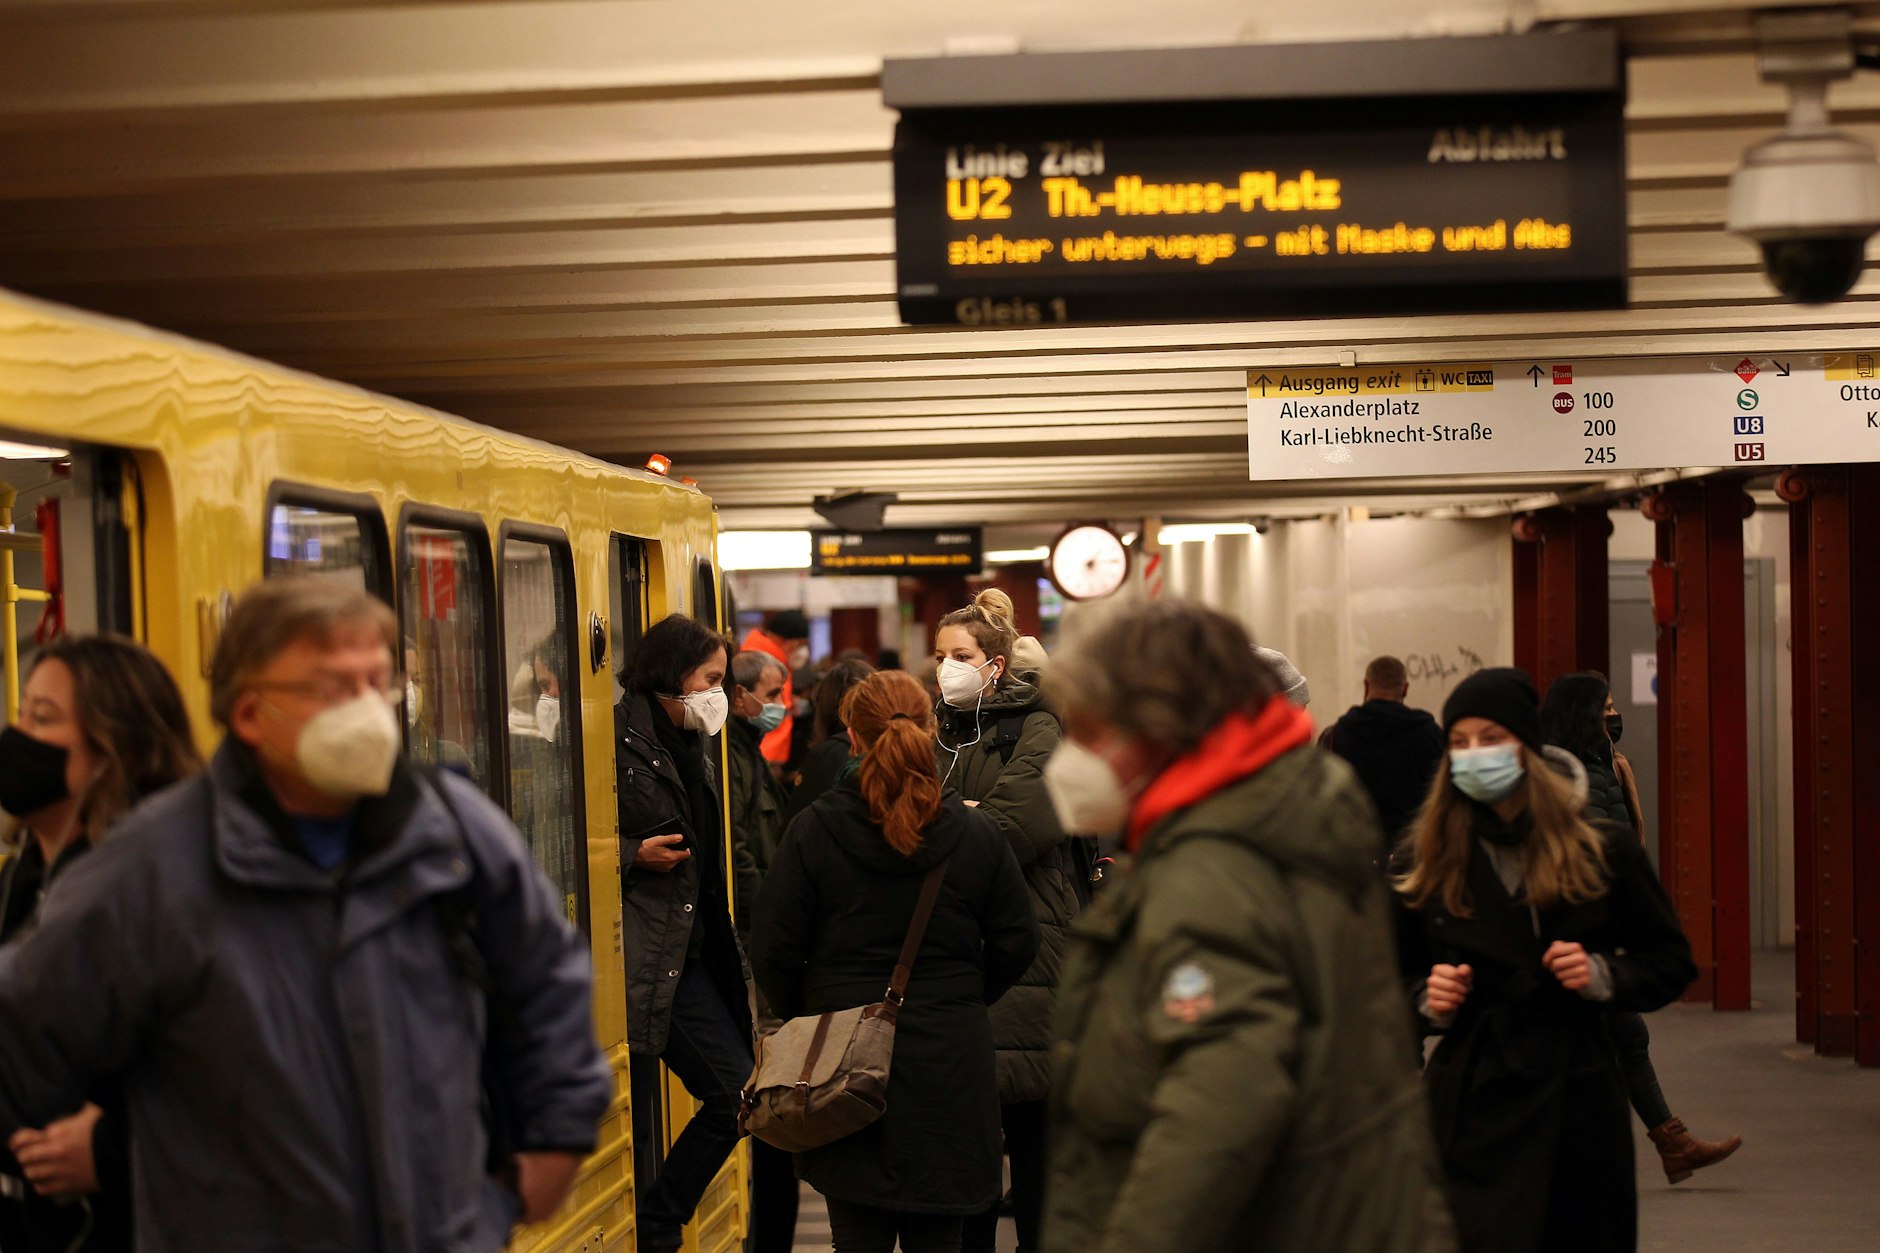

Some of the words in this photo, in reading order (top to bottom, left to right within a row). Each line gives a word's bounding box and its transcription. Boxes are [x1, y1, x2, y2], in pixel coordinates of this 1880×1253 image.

[1428, 127, 1567, 163] Abfahrt
[945, 146, 1028, 178] Linie
[1040, 140, 1105, 176] Ziel
[946, 179, 1012, 220] U2
[1042, 169, 1342, 216] Th.-Heuss-Platz
[947, 233, 1053, 266] sicher
[1061, 230, 1237, 265] unterwegs
[1276, 223, 1328, 256] mit
[1336, 220, 1435, 253] Maske
[1441, 218, 1507, 251] und
[955, 297, 1041, 324] Gleis
[1049, 297, 1068, 322] 1
[1279, 374, 1359, 395] Ausgang
[1366, 371, 1402, 389] exit
[1441, 372, 1465, 386] WC
[1467, 372, 1492, 384] TAXI
[1553, 371, 1573, 379] Tram
[1553, 398, 1574, 409] BUS
[1583, 392, 1614, 410] 100
[1740, 390, 1756, 409] S
[1840, 384, 1880, 401] Otto
[1280, 399, 1420, 420] Alexanderplatz
[1583, 420, 1616, 437] 200
[1736, 418, 1763, 433] U8
[1867, 411, 1880, 428] K
[1280, 423, 1493, 446] Karl-Liebknecht-Straße
[1584, 447, 1616, 464] 245
[1737, 444, 1763, 460] U5
